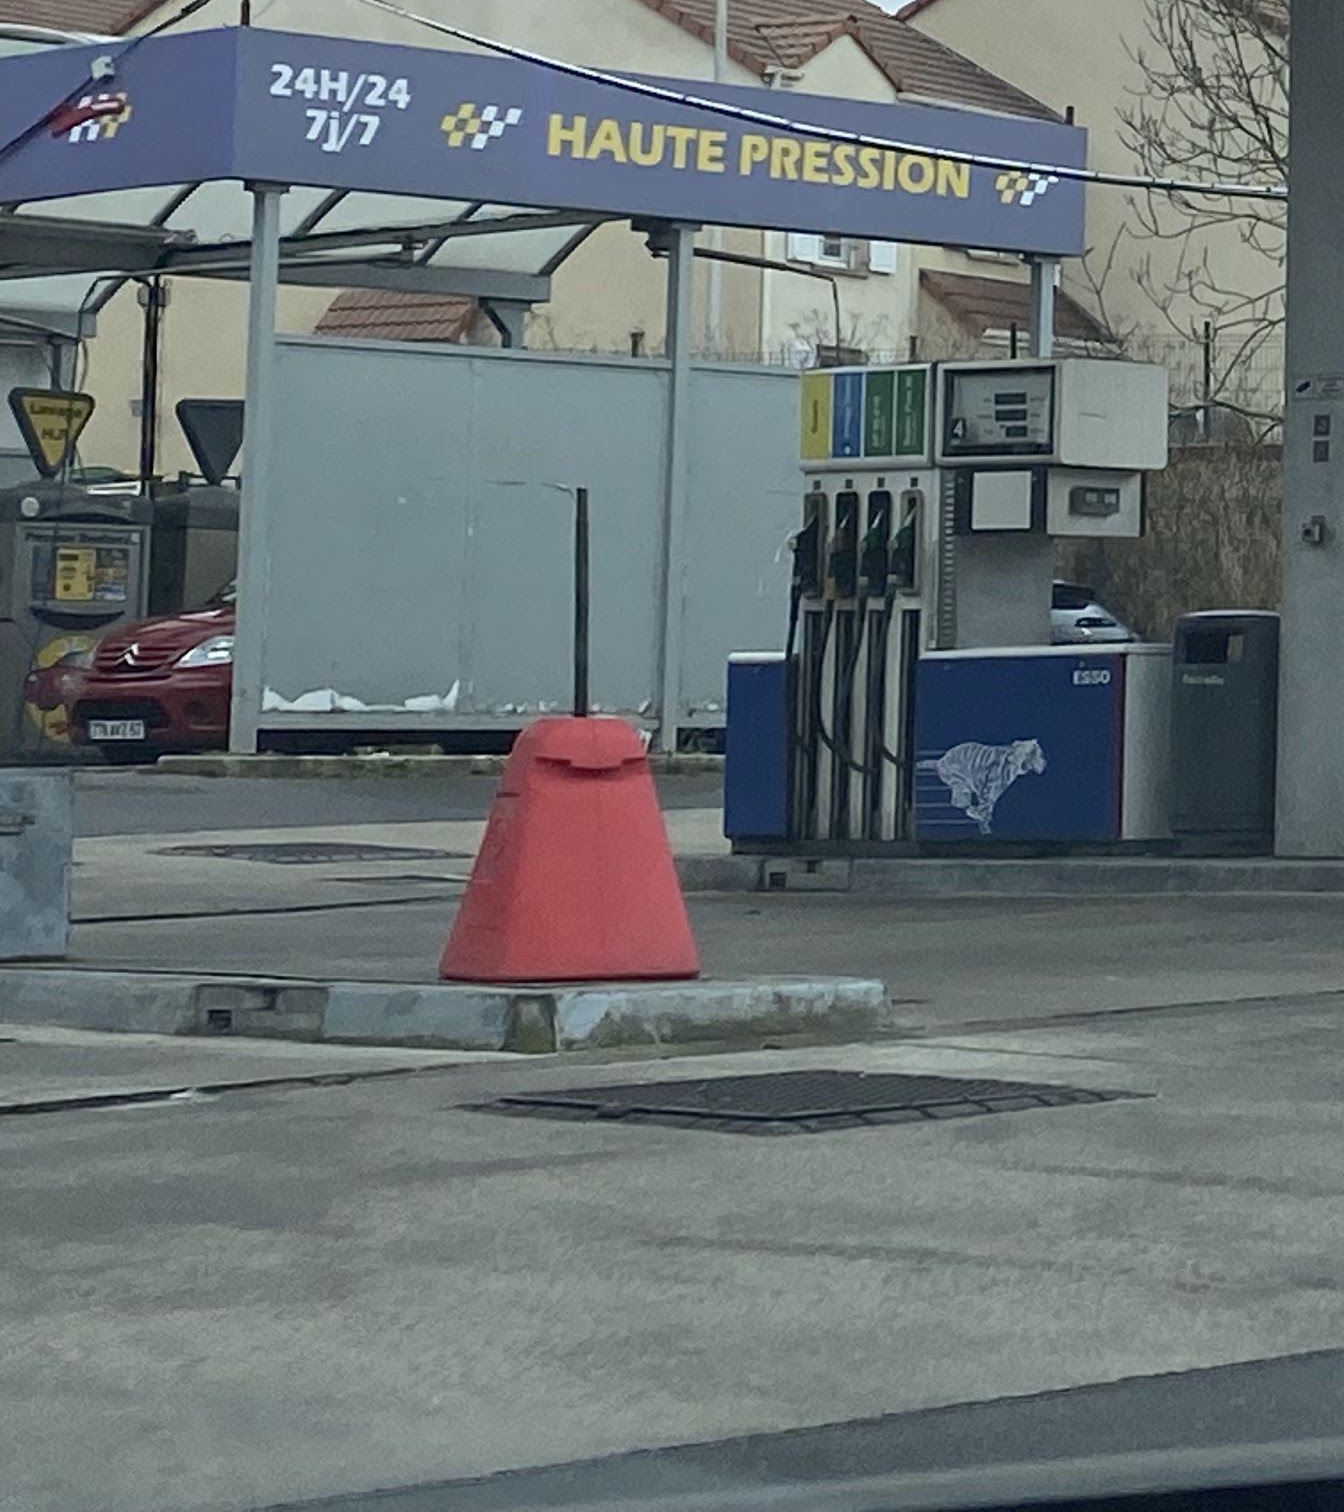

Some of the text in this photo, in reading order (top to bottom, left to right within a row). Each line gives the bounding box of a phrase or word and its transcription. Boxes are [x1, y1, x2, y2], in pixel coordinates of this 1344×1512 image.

[269, 63, 411, 112] 24H/24
[305, 107, 381, 153] 7j/7
[547, 113, 970, 198] HAUTE PRESSION
[1073, 670, 1111, 685] ESSO
